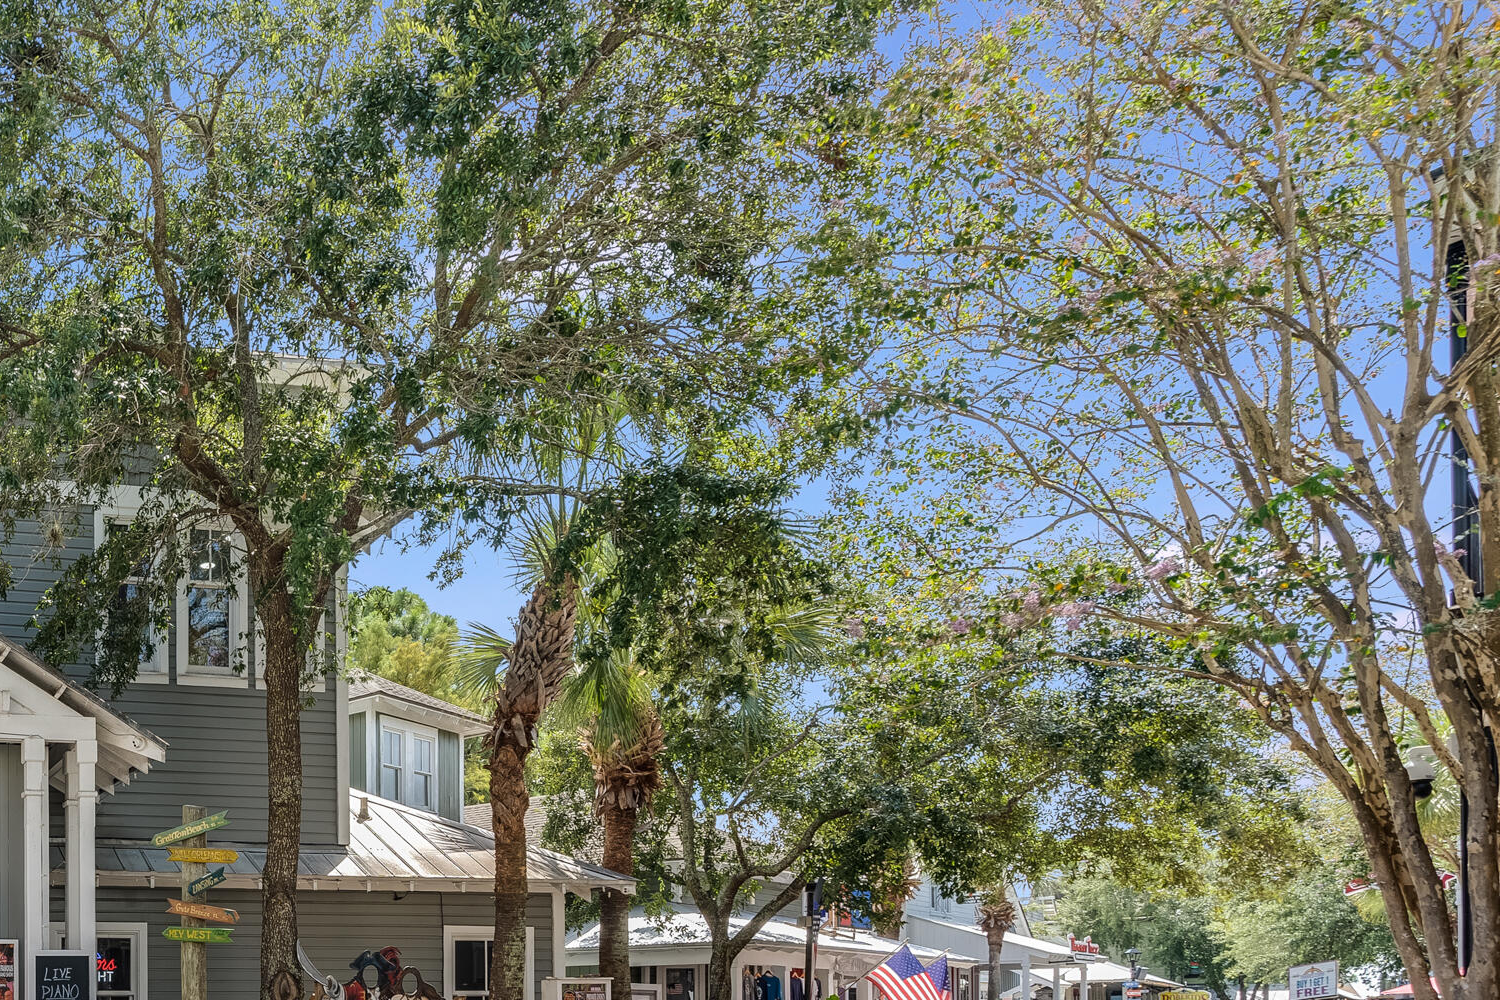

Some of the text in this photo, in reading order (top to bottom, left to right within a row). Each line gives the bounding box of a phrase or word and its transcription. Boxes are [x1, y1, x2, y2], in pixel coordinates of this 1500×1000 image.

[168, 928, 212, 940] KEY WEST
[43, 967, 73, 981] LIVE
[1296, 979, 1307, 989] BUY
[1313, 976, 1325, 987] GET
[41, 983, 80, 1000] PIANO
[1296, 985, 1329, 998] FREE
